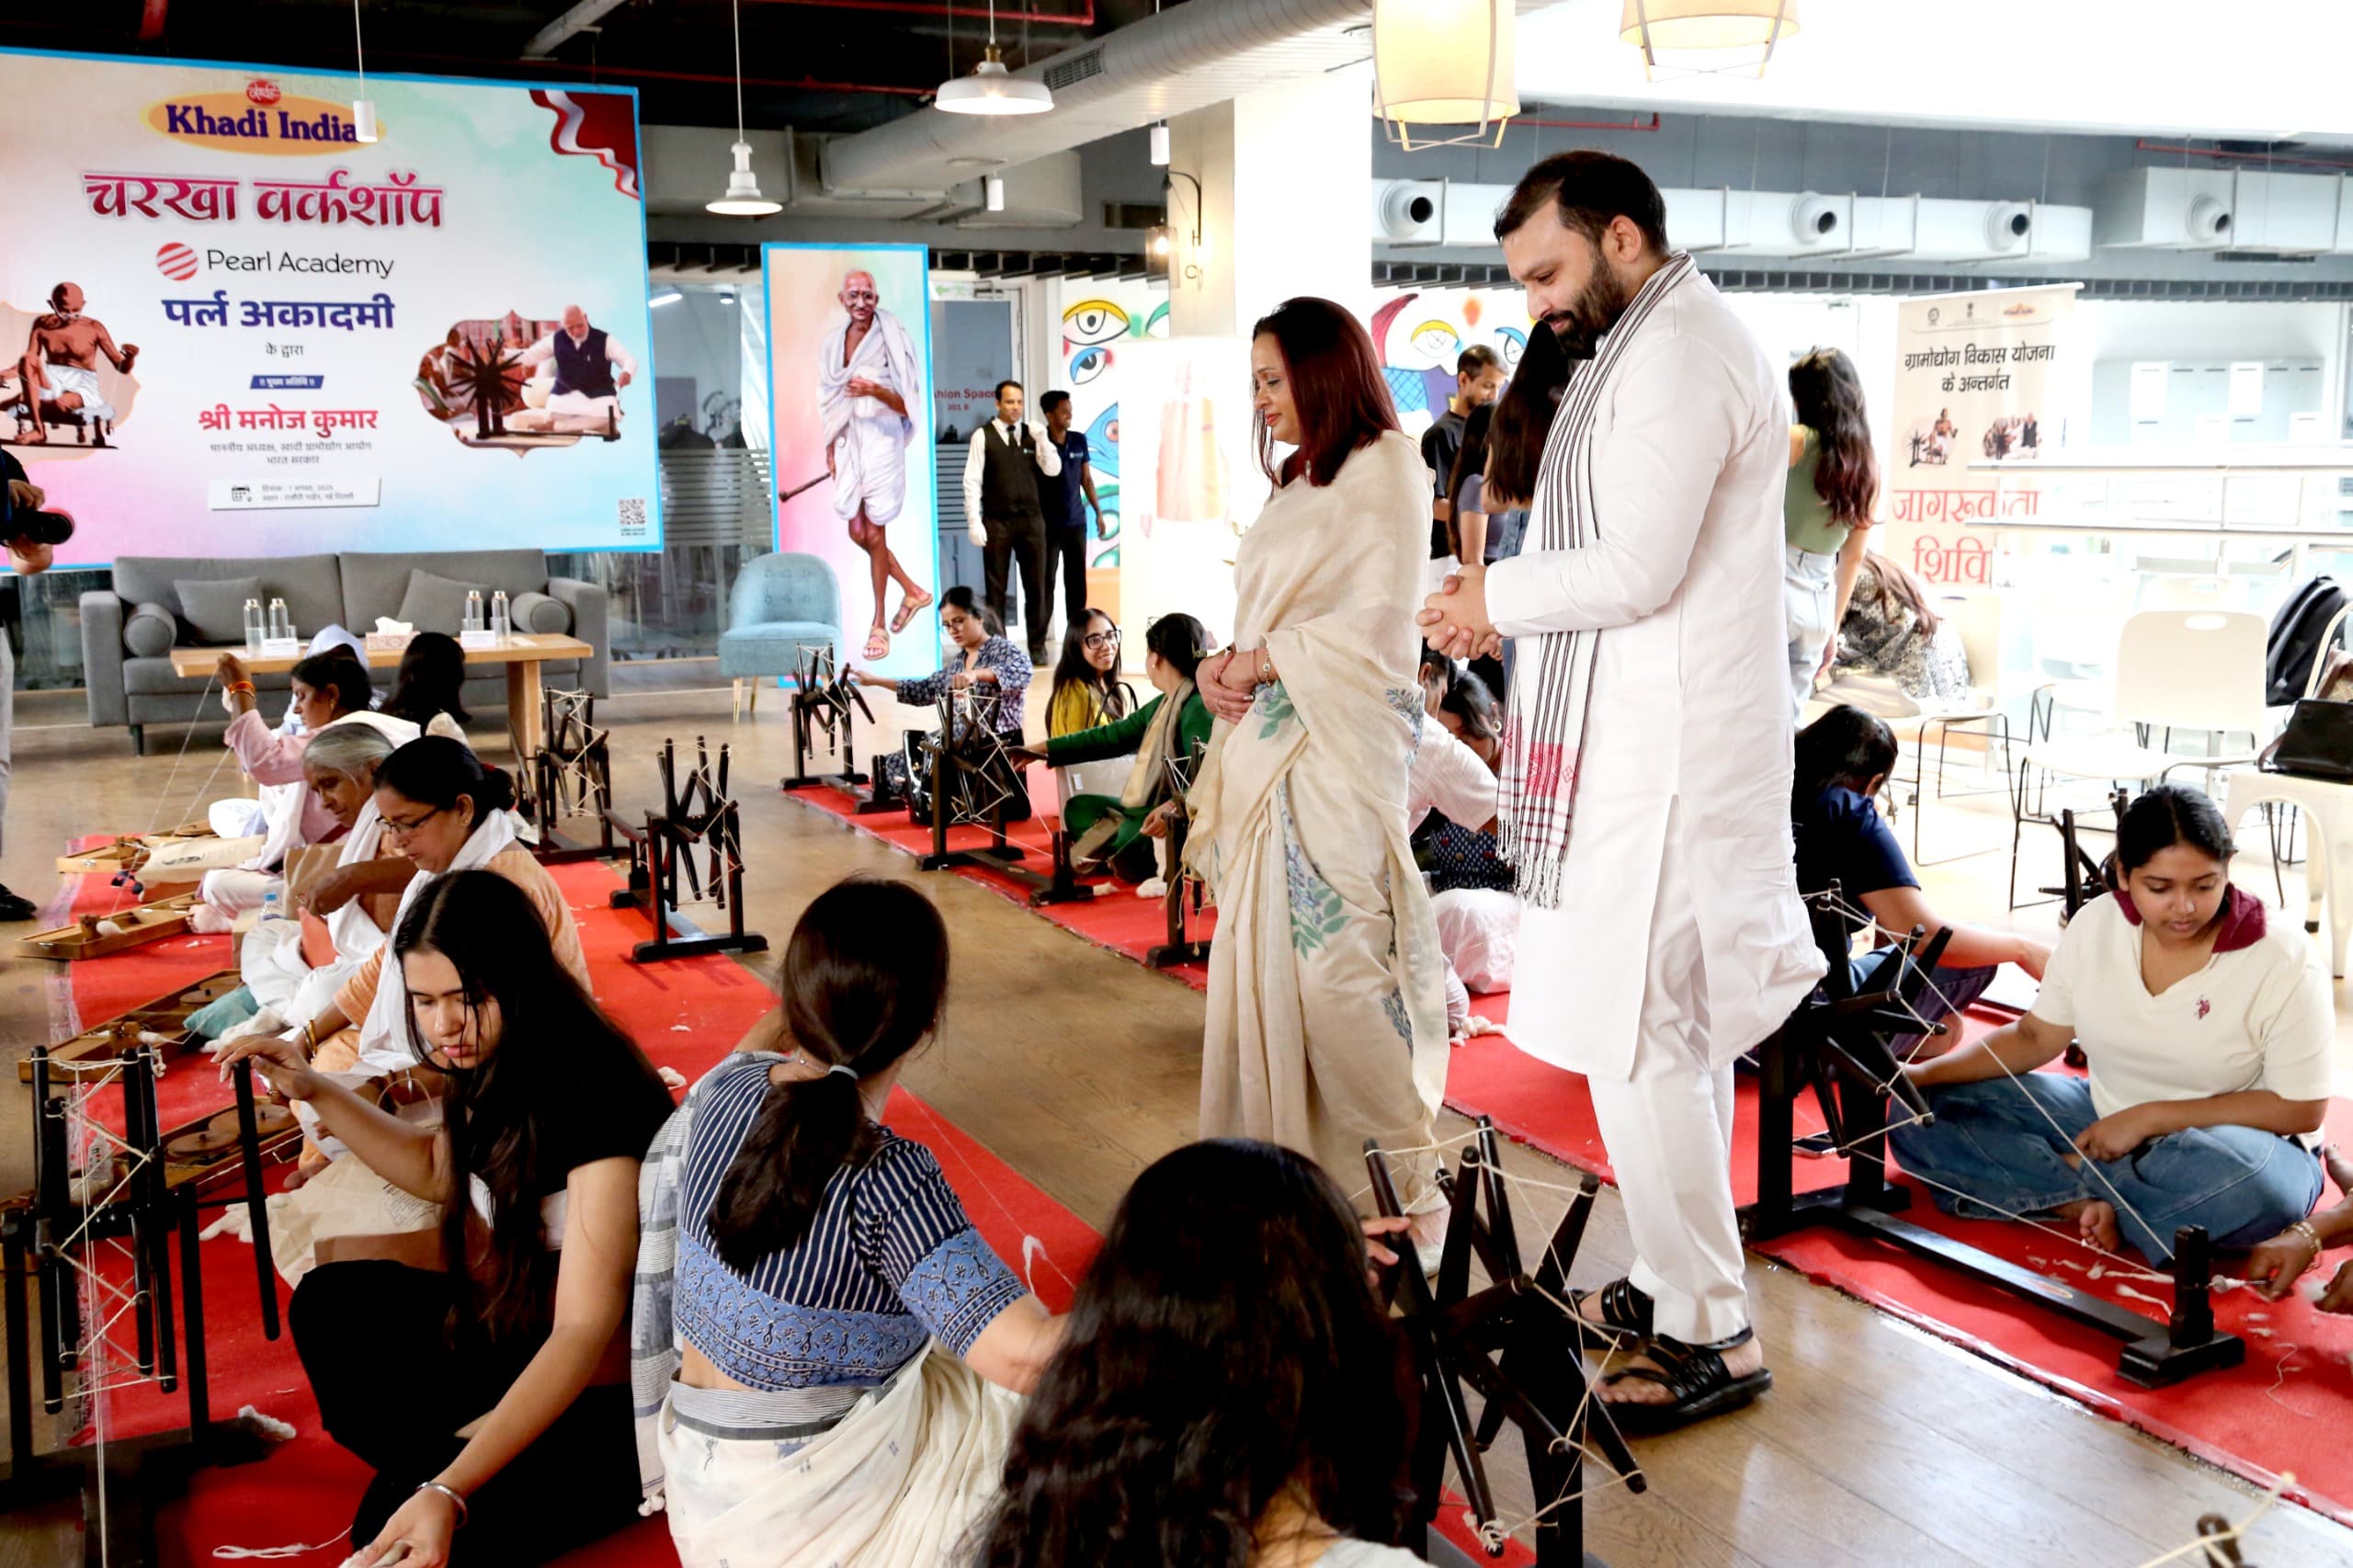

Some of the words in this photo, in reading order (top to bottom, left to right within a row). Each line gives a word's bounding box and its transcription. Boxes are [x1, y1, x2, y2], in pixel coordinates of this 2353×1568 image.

[165, 104, 269, 138] Khadi
[278, 111, 360, 142] India
[84, 174, 239, 221] चरखा
[254, 169, 443, 227] वर्कशॉप
[207, 249, 271, 272] Pearl
[278, 252, 394, 278] Academy
[161, 290, 230, 326] पर्ल
[240, 293, 395, 331] अकादमी
[265, 341, 278, 356] के
[281, 343, 304, 358] द्वारा
[1904, 346, 1961, 371] ग्रामोद्योग
[1964, 343, 2007, 366] विकास
[2011, 340, 2056, 362] योजना
[1941, 371, 1955, 392] के
[1958, 369, 2011, 392] अन्तर्गत
[199, 403, 232, 430] श्री
[237, 403, 306, 430] मनोज
[312, 410, 378, 438] कुमार
